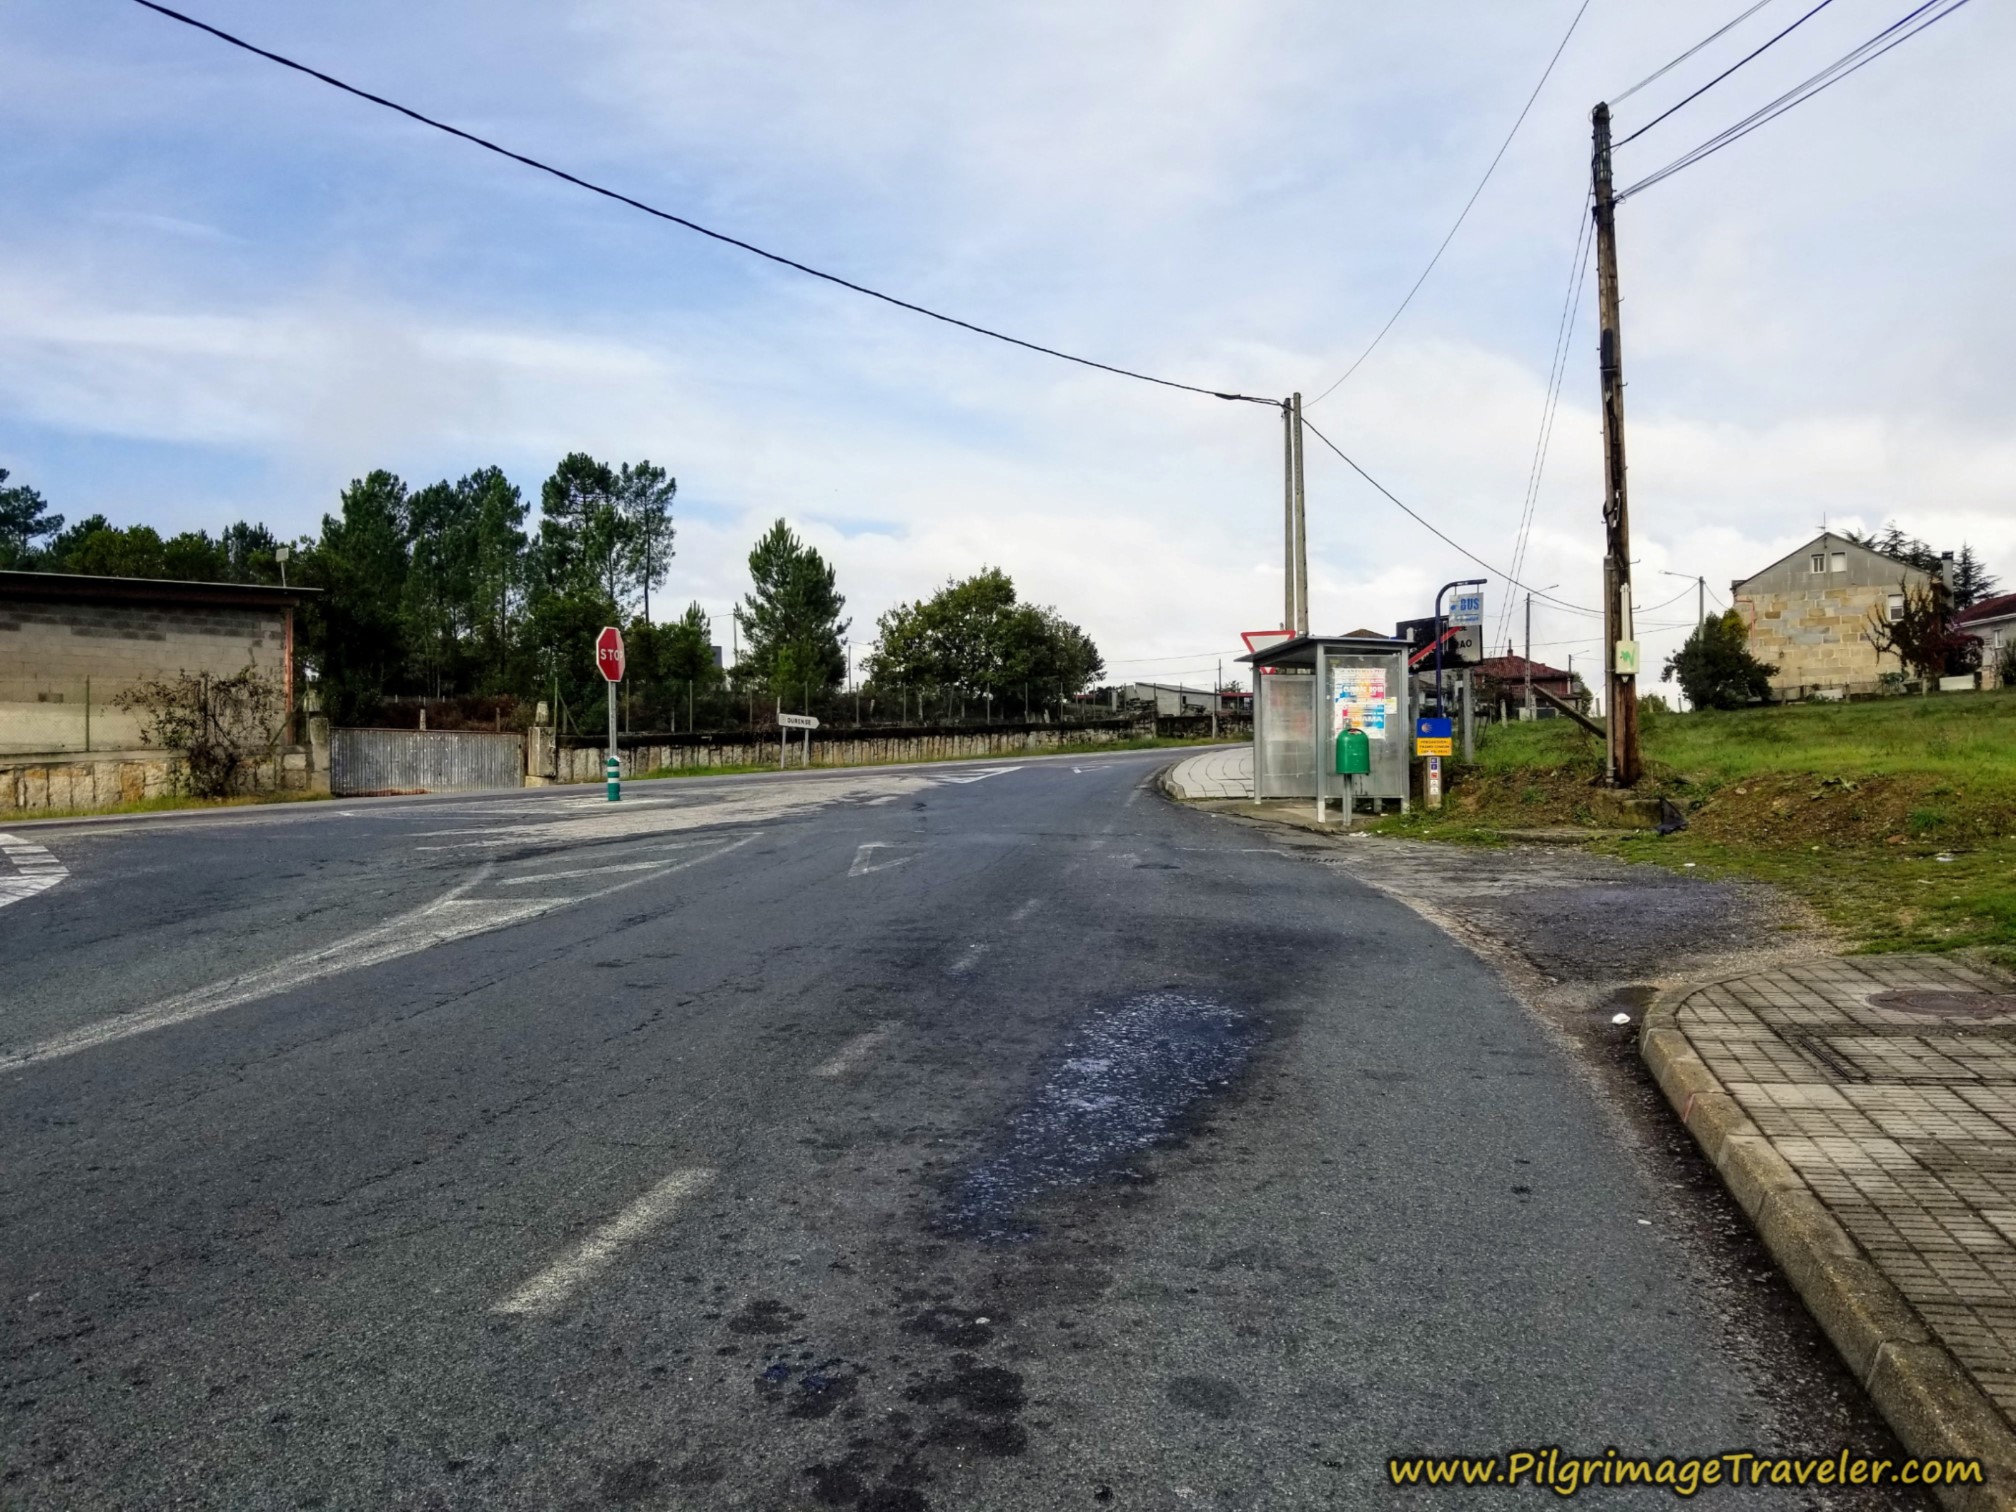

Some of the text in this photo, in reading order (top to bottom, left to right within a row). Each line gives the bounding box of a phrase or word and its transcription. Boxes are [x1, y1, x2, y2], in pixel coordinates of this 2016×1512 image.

[1460, 598, 1480, 611] BUS
[600, 648, 624, 662] STOP
[786, 717, 811, 726] OURENSE
